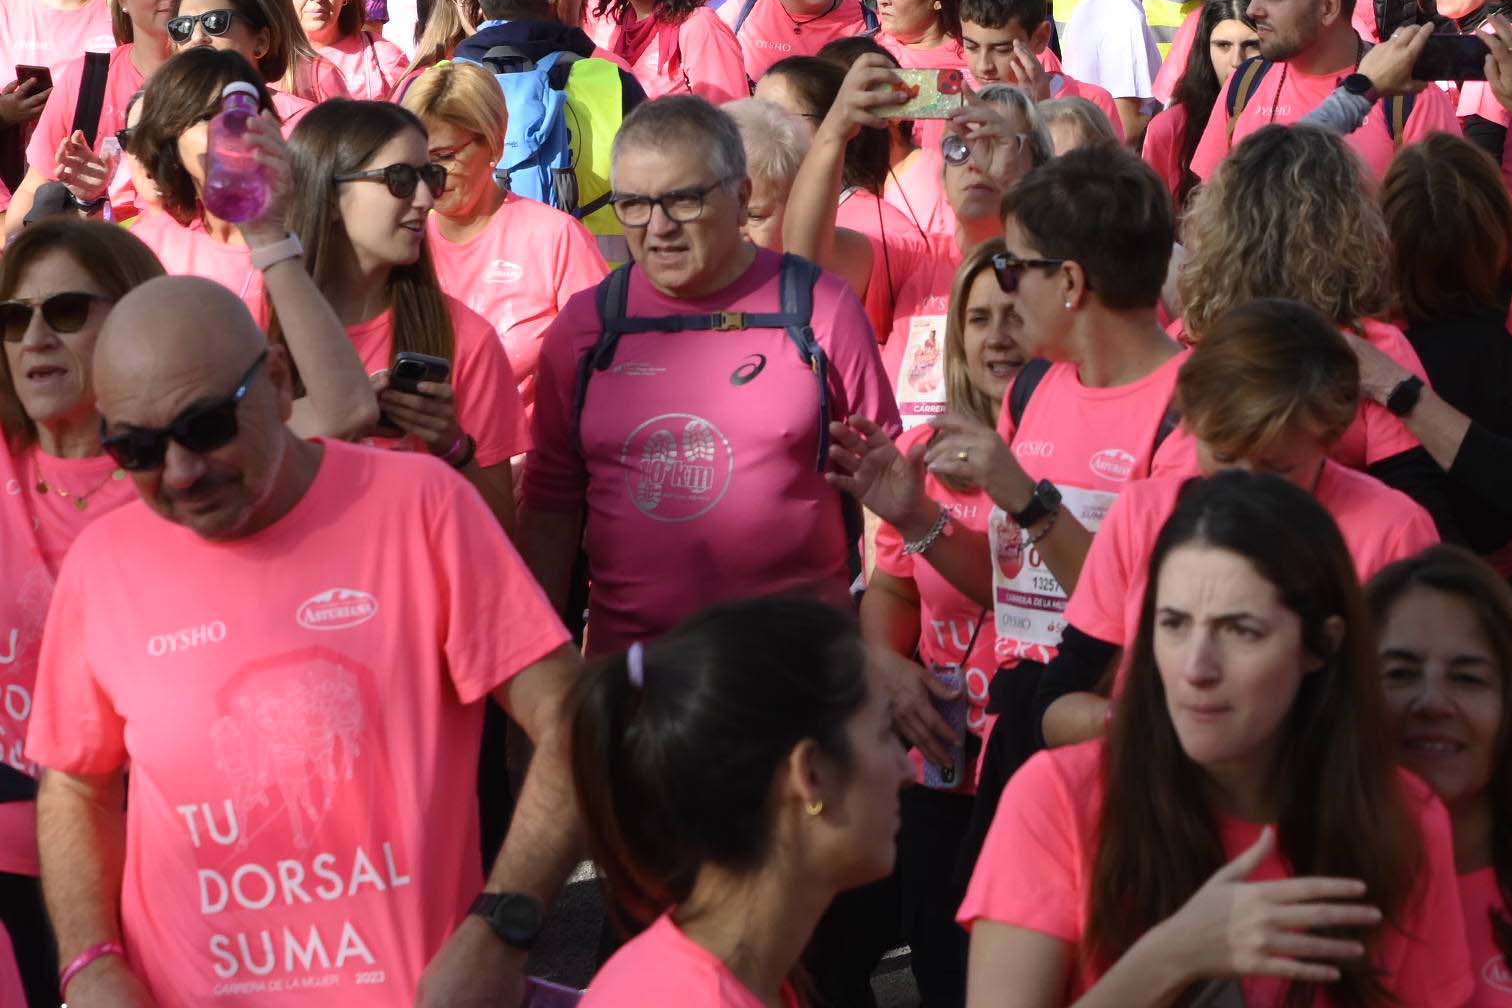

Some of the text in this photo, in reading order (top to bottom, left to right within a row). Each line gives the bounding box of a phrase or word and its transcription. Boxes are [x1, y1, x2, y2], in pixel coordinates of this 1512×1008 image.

[148, 602, 372, 656] OYSHO ASTURIANA
[932, 620, 974, 651] TU
[177, 799, 239, 848] TU
[198, 841, 411, 914] DORSAL
[210, 921, 375, 977] SUMA
[214, 971, 386, 995] CARRERA DE LA MUJER 2023
